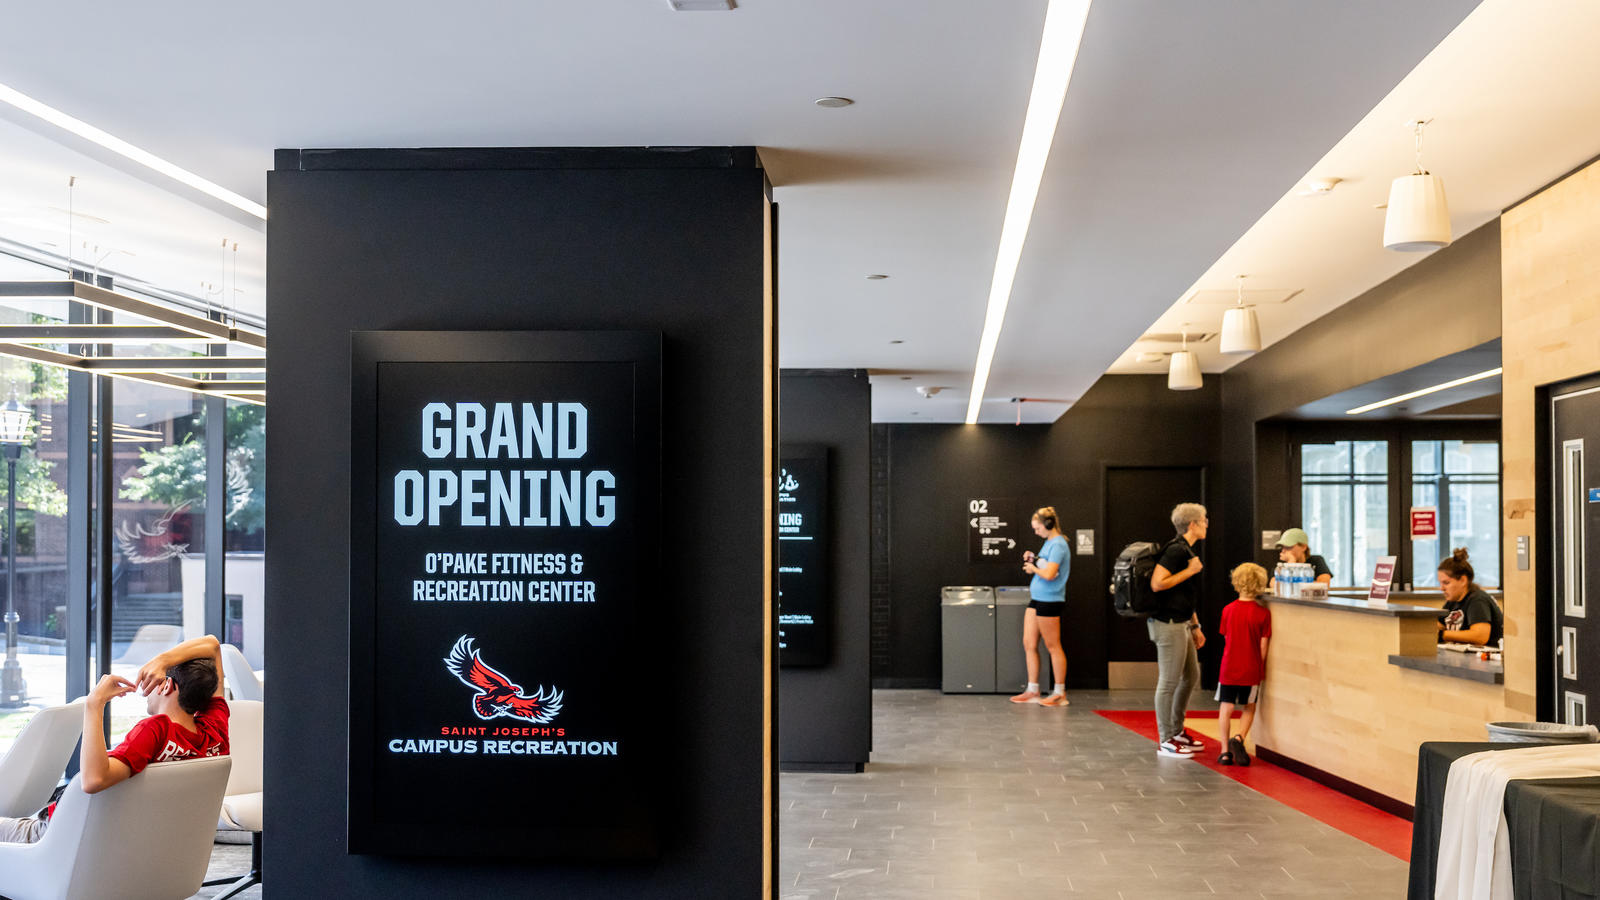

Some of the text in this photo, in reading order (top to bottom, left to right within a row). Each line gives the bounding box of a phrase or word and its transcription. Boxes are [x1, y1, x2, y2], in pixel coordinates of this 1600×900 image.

[422, 402, 588, 459] GRAND
[394, 469, 616, 527] OPENING
[969, 500, 988, 513] 02
[425, 552, 584, 575] O'PAKE FITNESS &
[413, 580, 596, 603] RECREATION CENTER
[441, 727, 566, 737] SAINT JOSEPH'S
[388, 739, 618, 756] CAMPUS RECREATION
